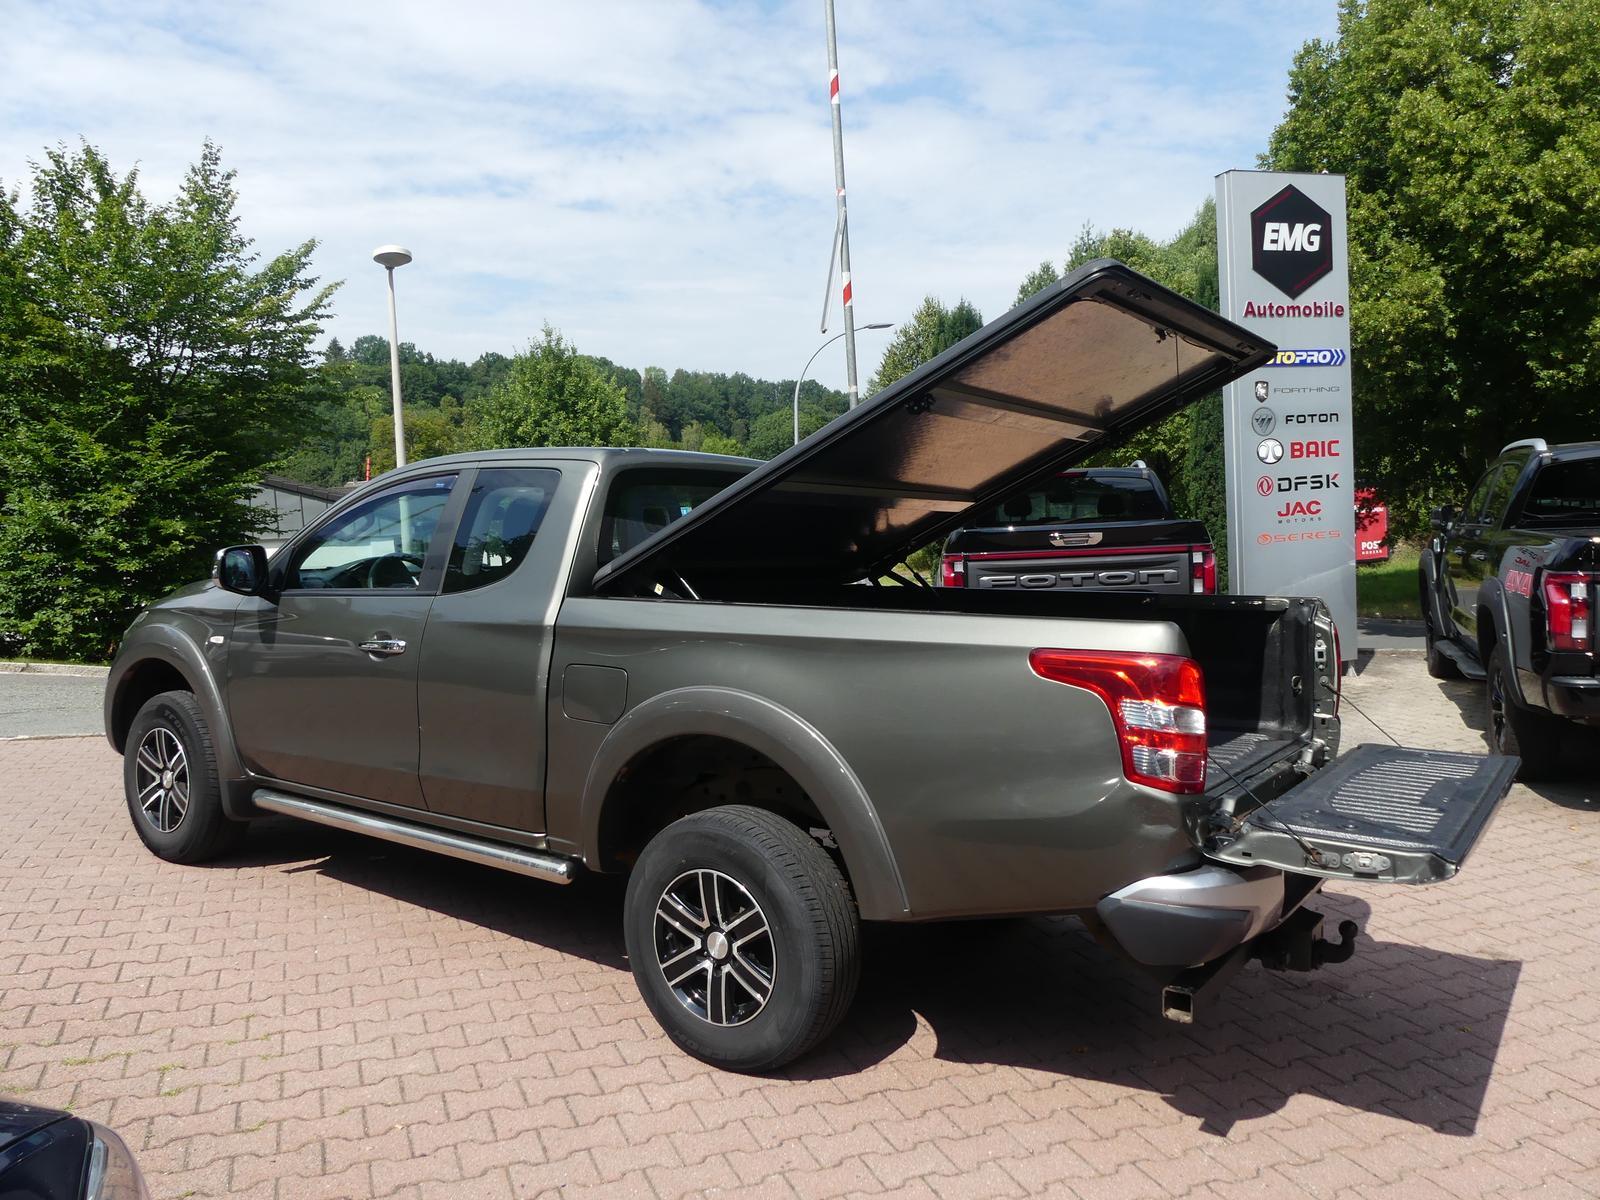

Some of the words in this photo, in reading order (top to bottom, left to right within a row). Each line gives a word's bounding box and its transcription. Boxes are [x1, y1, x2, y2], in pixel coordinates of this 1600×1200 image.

[1262, 222, 1322, 252] EMG
[1243, 301, 1345, 318] Automobile
[1273, 386, 1340, 394] FORTHING
[1285, 413, 1339, 424] FOTON
[1290, 440, 1340, 459] BAIC
[1277, 473, 1340, 493] DFSK
[1277, 500, 1321, 517] JAC
[1273, 530, 1341, 543] SERES
[978, 569, 1179, 588] FOTON
